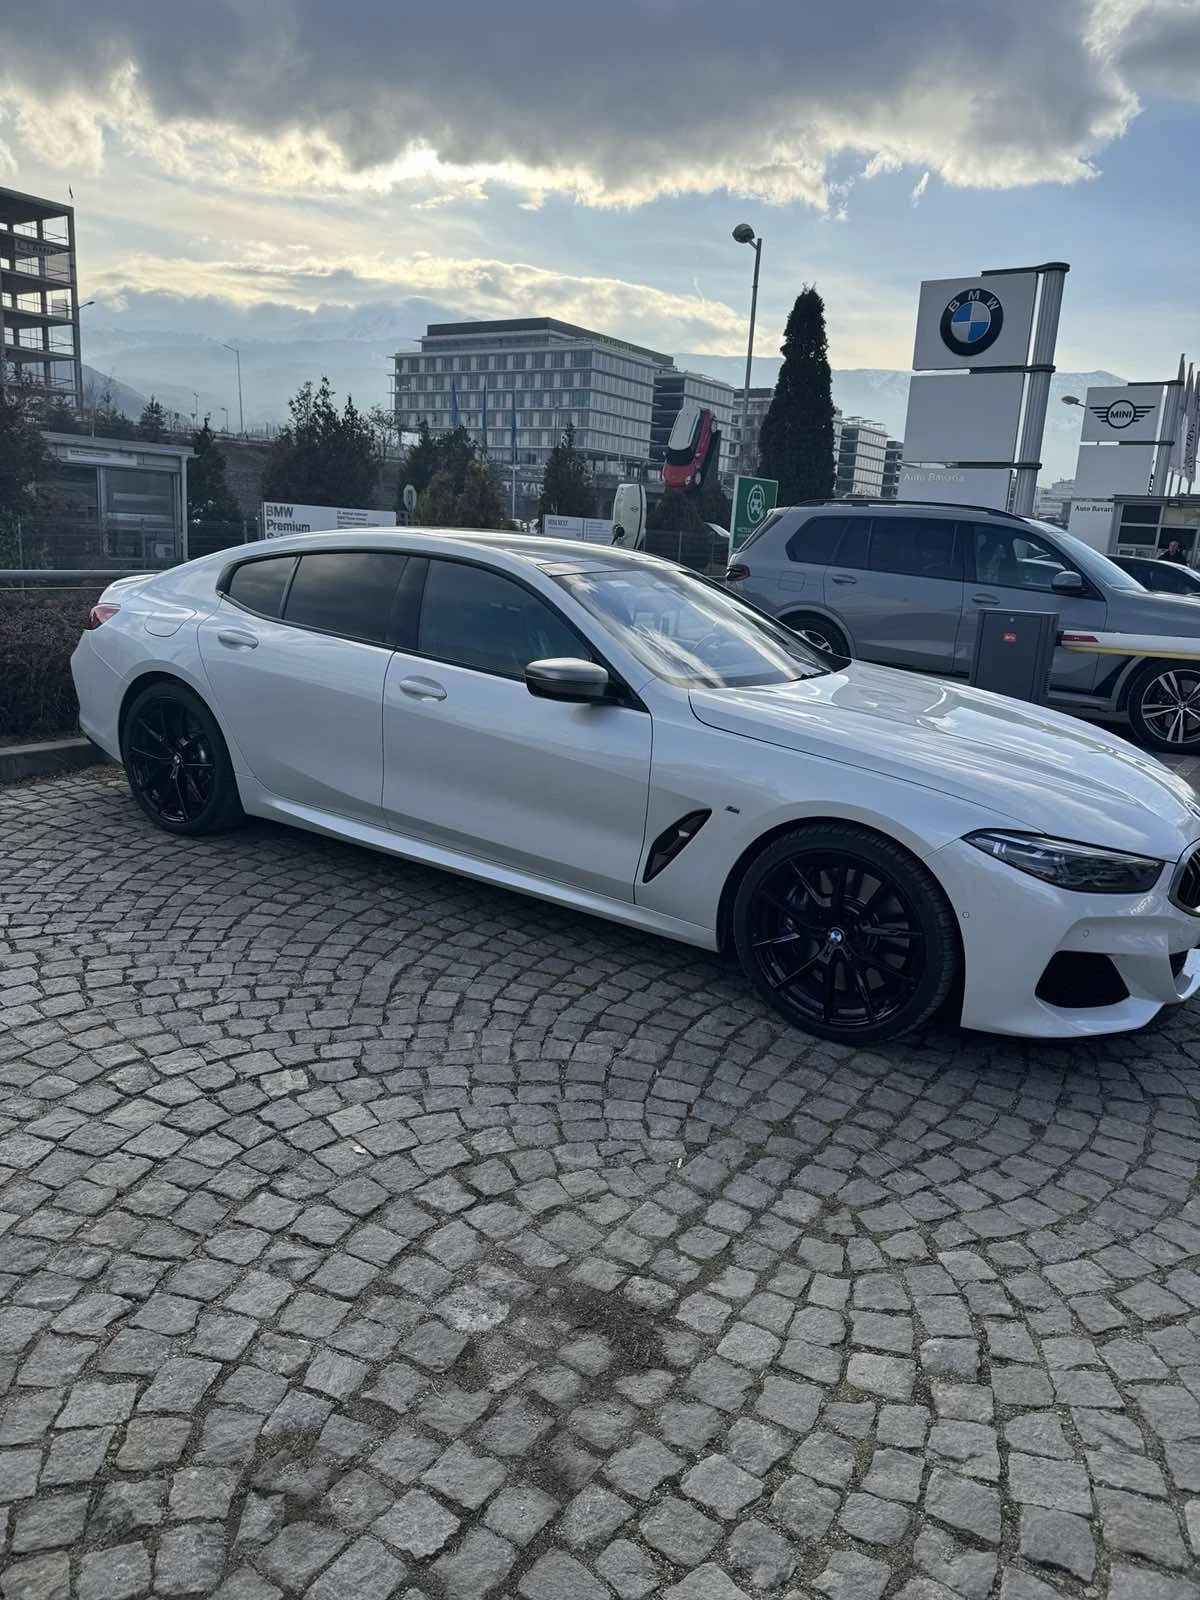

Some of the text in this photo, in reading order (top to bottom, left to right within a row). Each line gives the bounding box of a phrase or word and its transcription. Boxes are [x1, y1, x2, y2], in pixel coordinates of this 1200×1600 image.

[948, 290, 1001, 312] BMW
[1110, 410, 1132, 419] MINI
[266, 505, 294, 518] BMW
[1074, 504, 1113, 513] Auto Bavari
[267, 519, 311, 533] Premium
